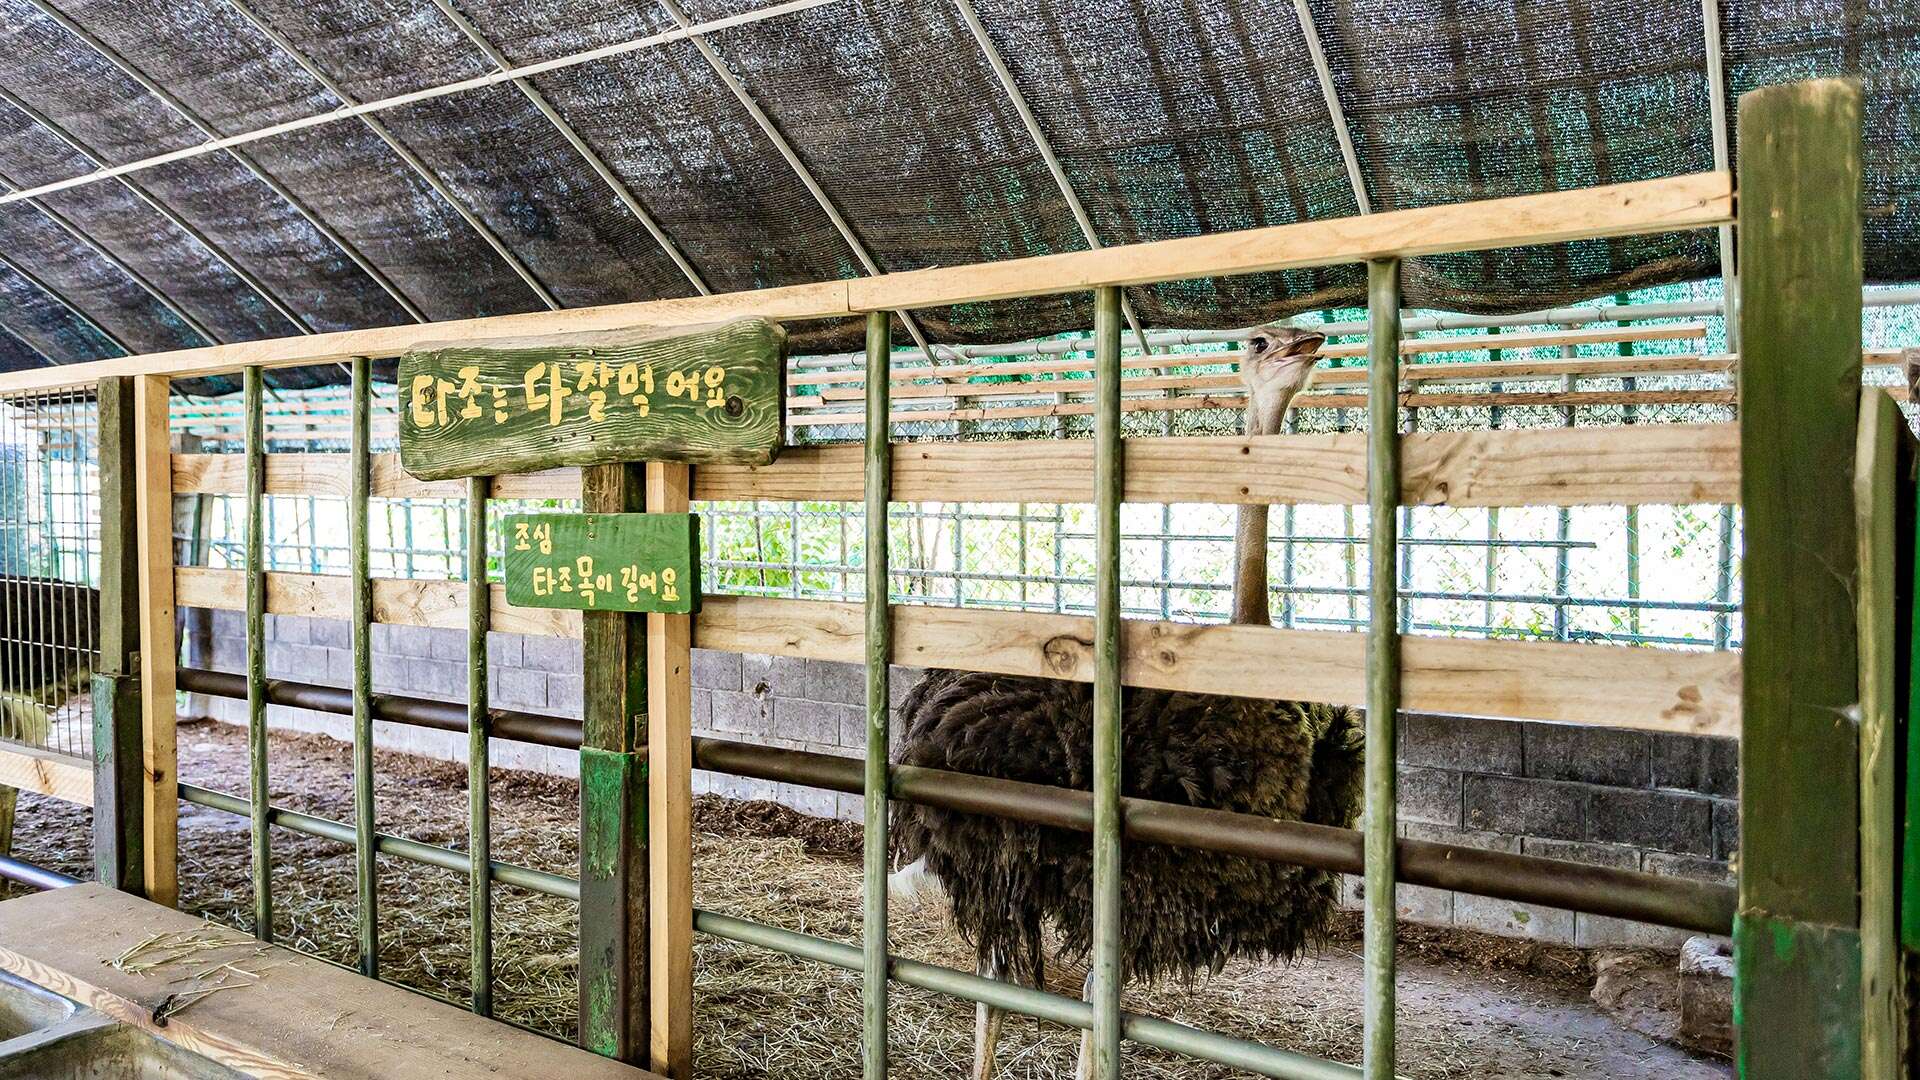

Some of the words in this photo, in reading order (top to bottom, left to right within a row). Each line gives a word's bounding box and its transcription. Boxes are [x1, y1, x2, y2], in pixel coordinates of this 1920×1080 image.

[412, 366, 509, 428] 타조는
[514, 522, 552, 555] 조심
[620, 564, 680, 603] 길어요
